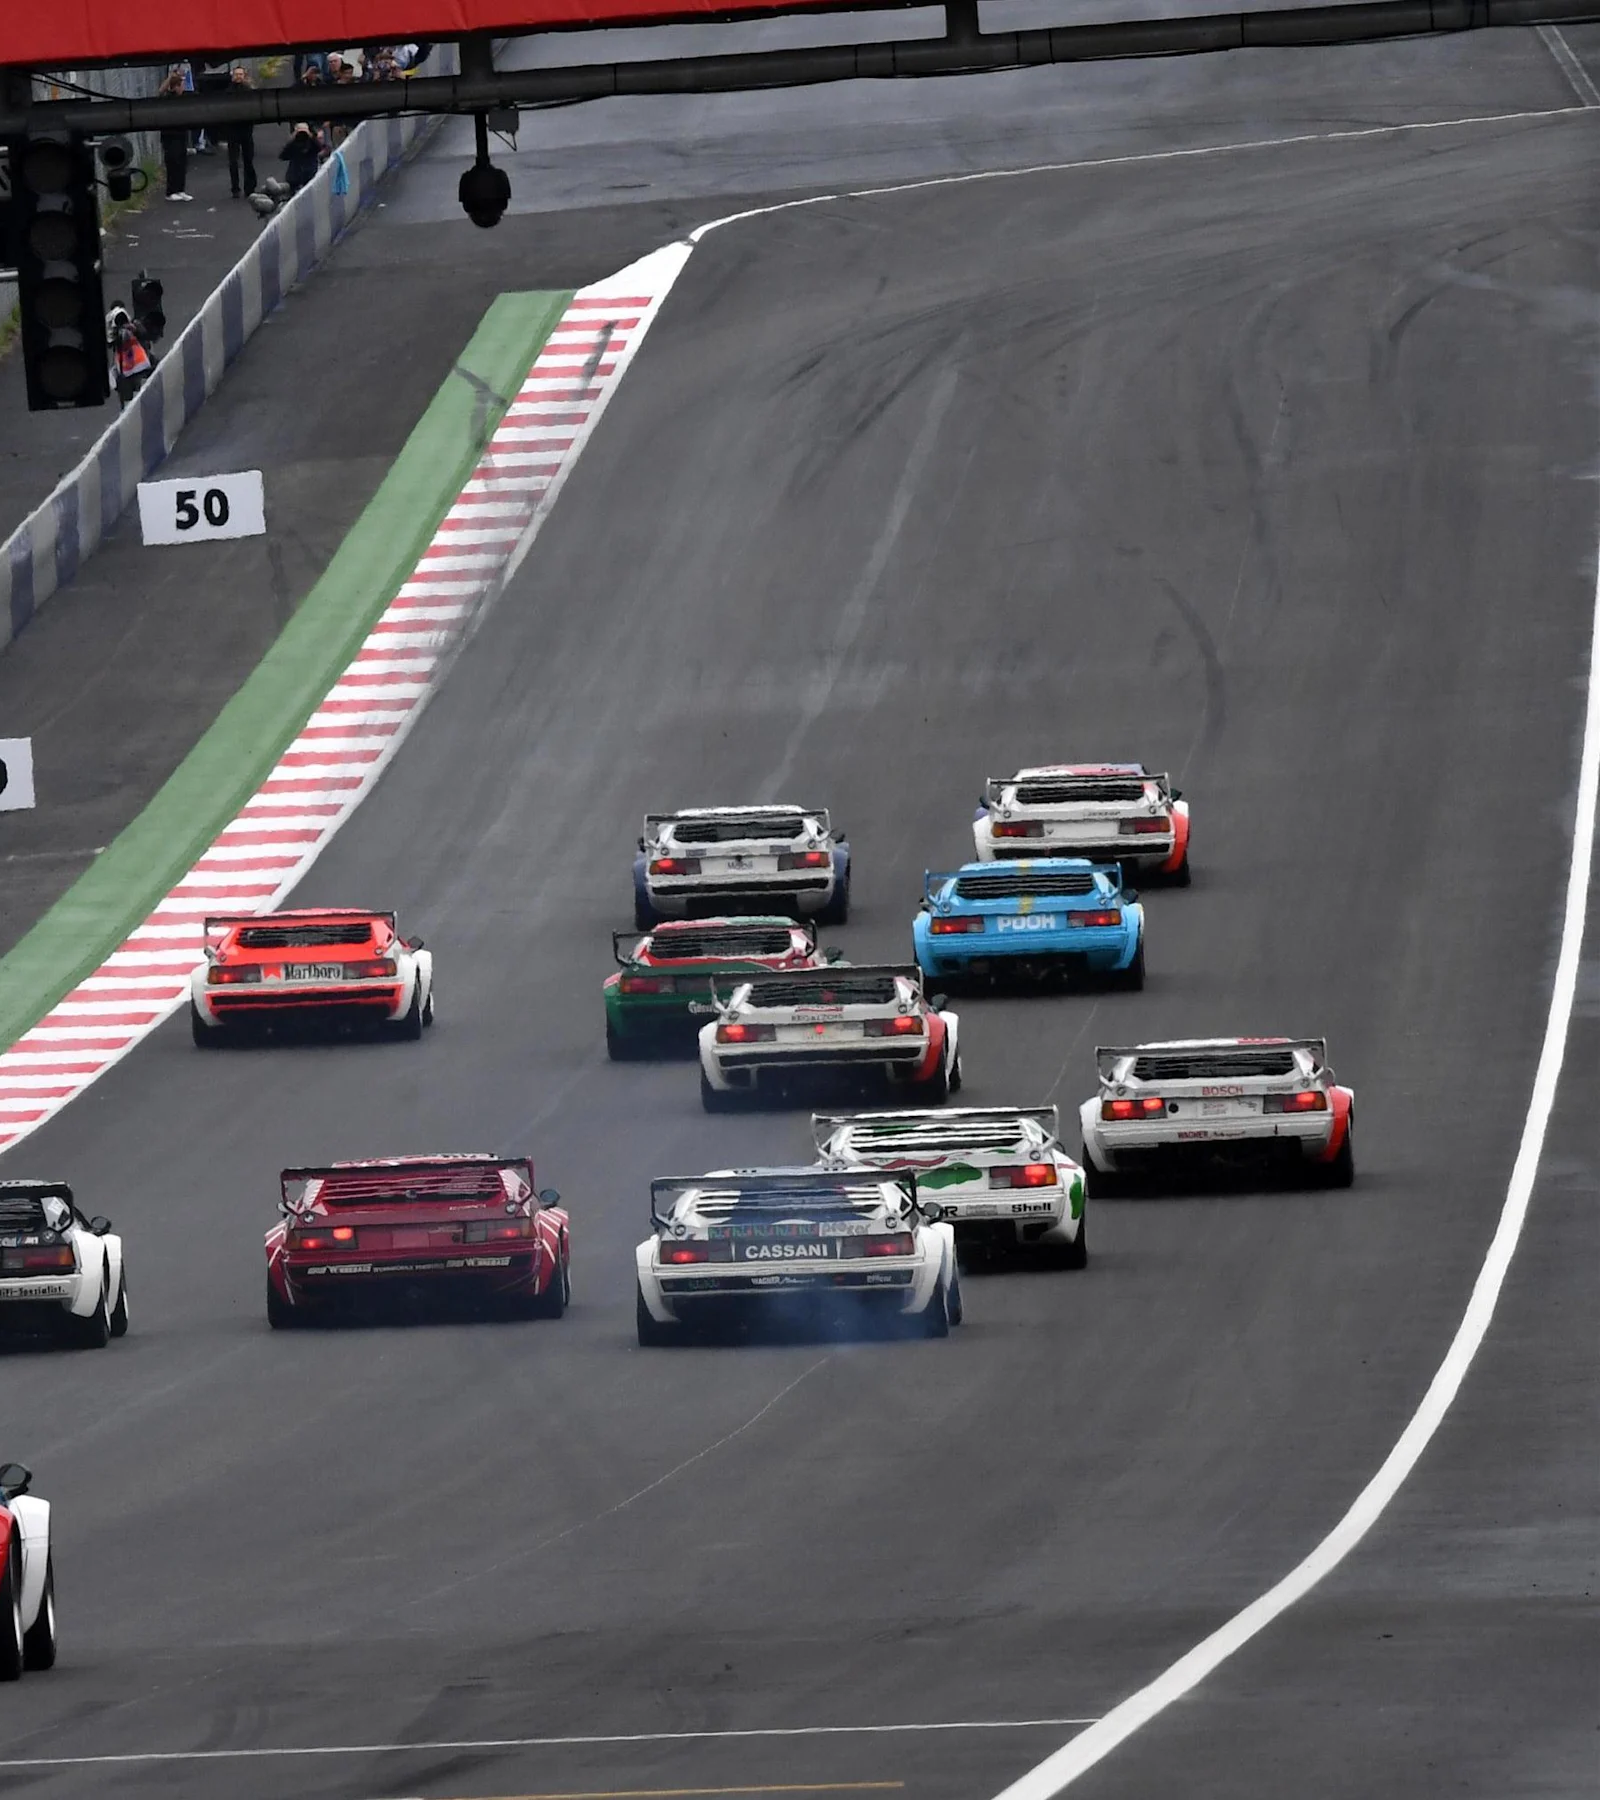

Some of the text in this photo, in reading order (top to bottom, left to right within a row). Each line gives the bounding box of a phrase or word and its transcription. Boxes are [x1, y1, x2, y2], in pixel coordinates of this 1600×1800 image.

[176, 489, 229, 530] 50
[997, 915, 1056, 931] POOH
[284, 964, 341, 980] Marlboro
[1202, 1086, 1243, 1096] BOSCH
[1011, 1202, 1052, 1213] Shell
[745, 1244, 827, 1259] CASSANI
